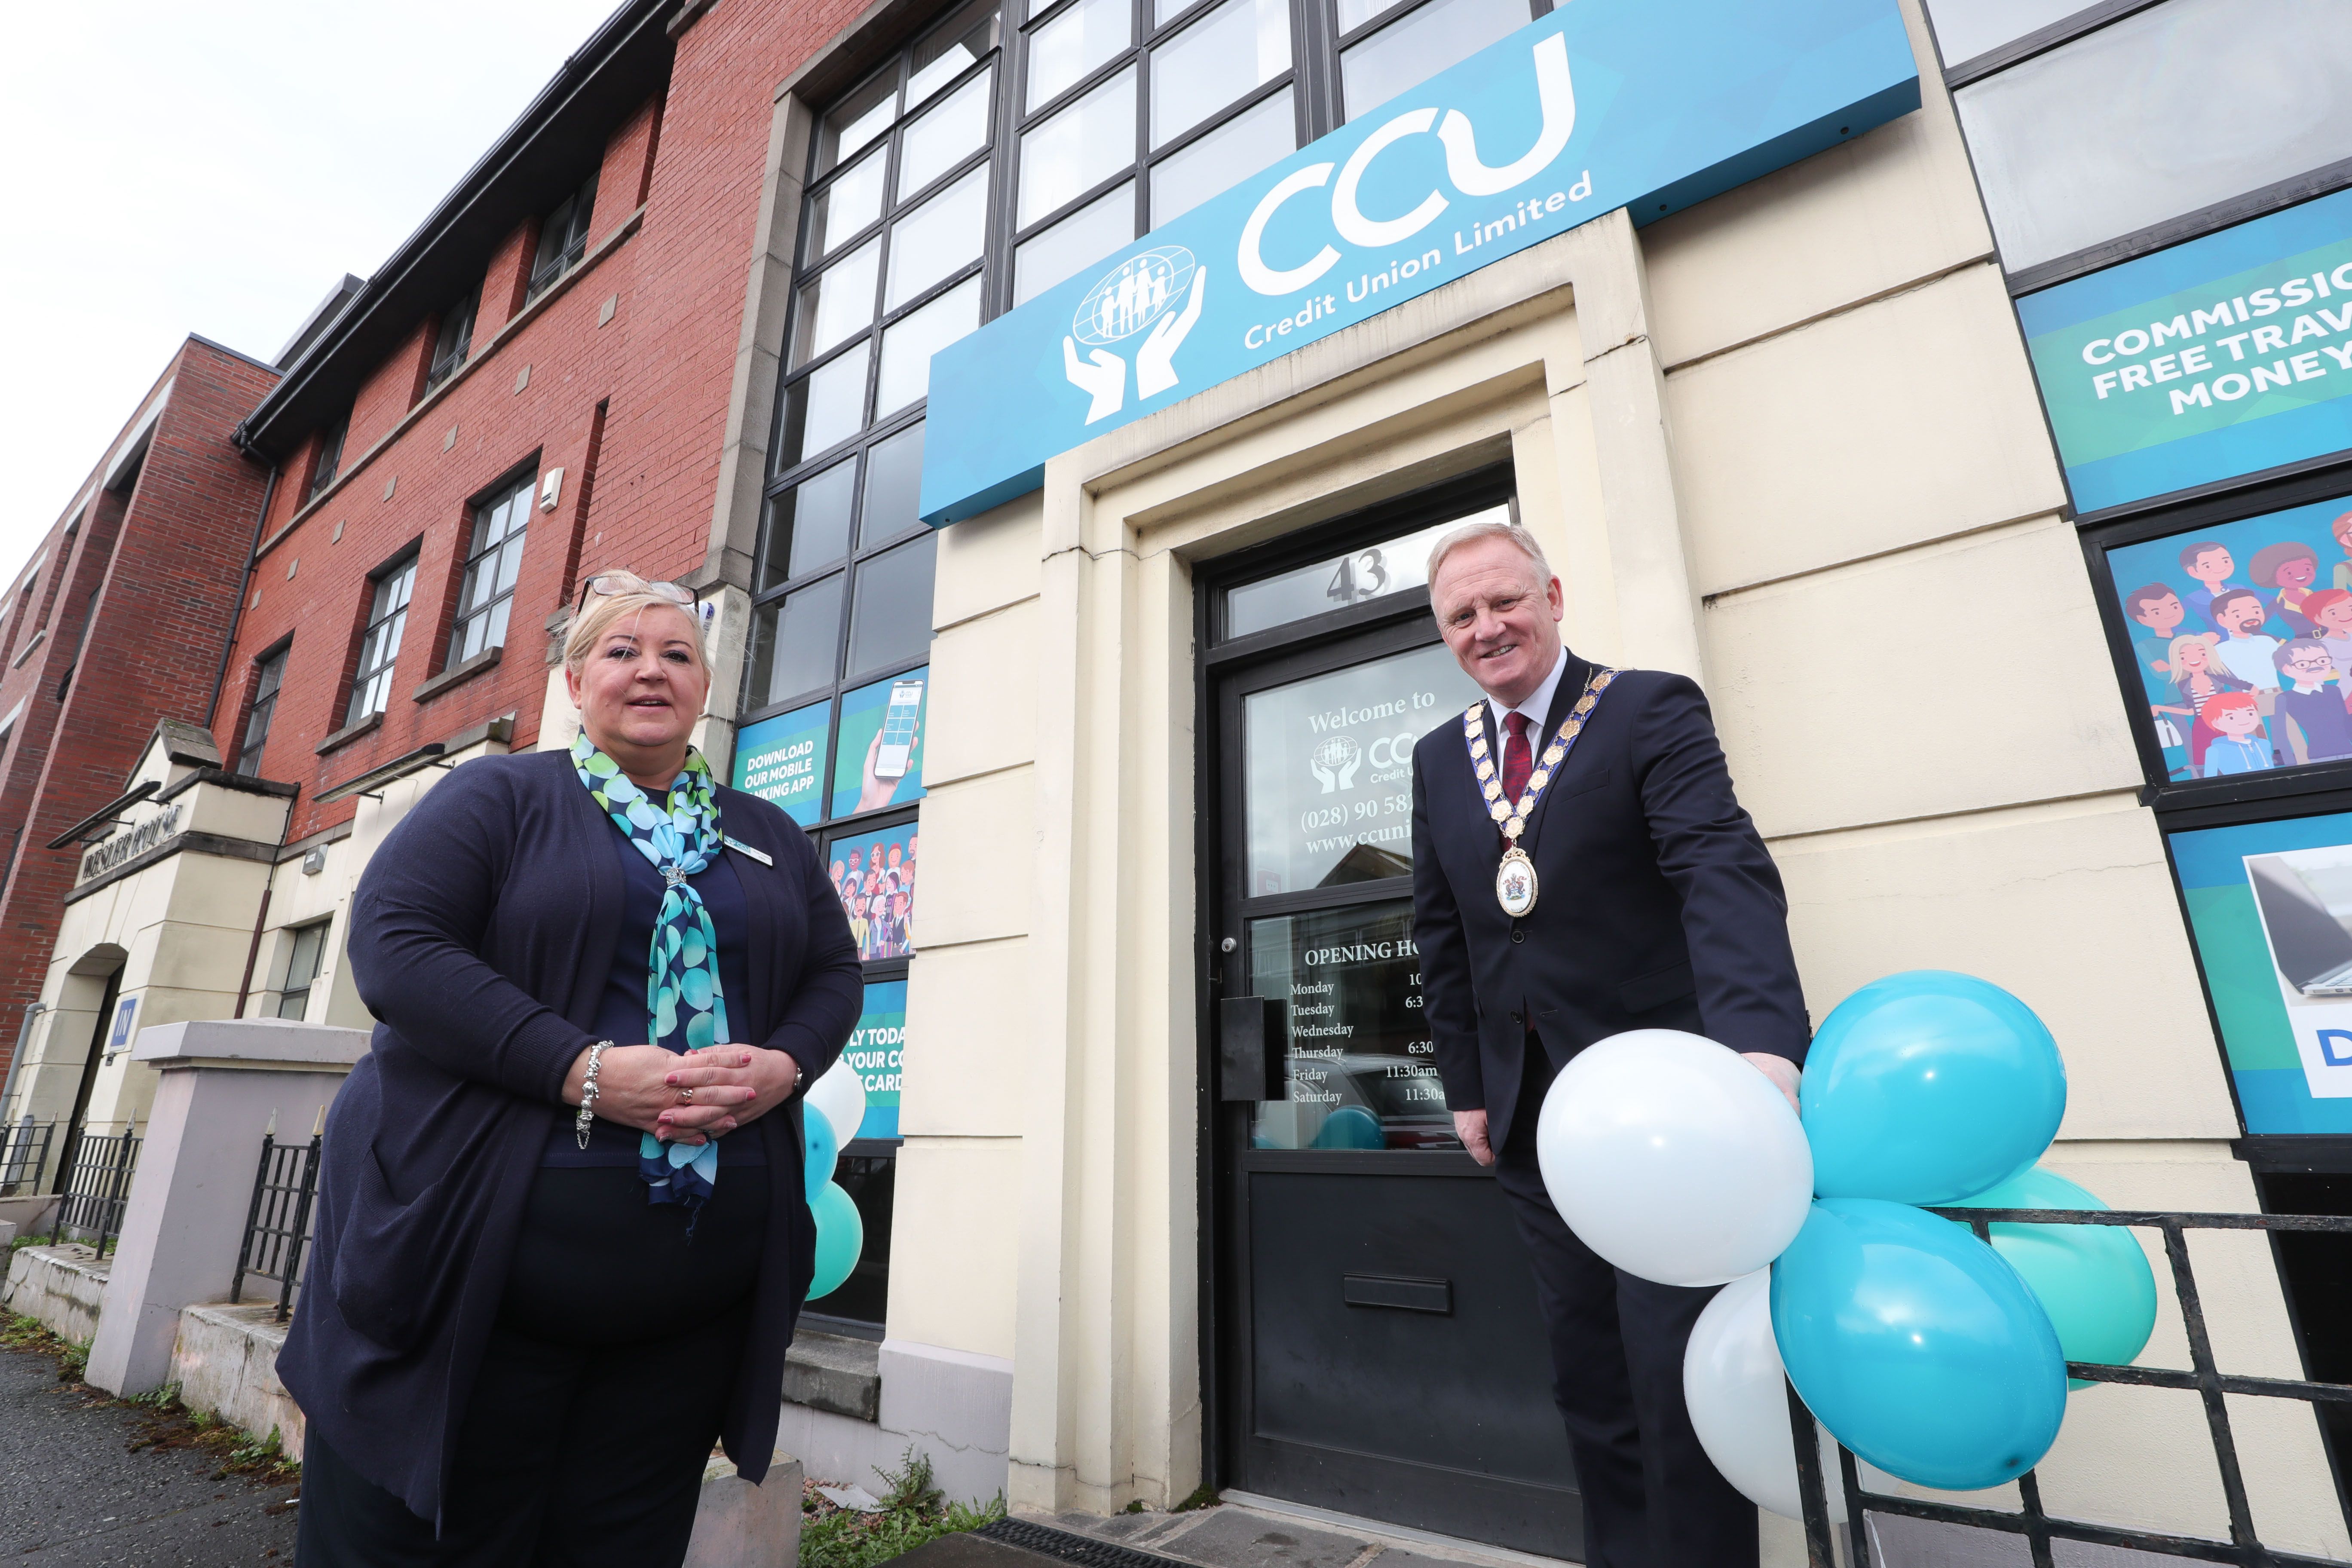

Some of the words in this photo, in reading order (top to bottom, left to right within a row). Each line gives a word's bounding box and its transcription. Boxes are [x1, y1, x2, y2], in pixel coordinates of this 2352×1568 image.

[1237, 31, 1576, 296] CCU
[1245, 293, 1335, 349] Credit
[1346, 245, 1441, 303] Union
[1455, 169, 1592, 256] Limited
[2082, 262, 2352, 365] COMMISSIO
[2092, 345, 2213, 400] FREE
[2216, 301, 2352, 361] TRAV
[2169, 340, 2352, 415] MONEY
[1327, 548, 1386, 601] 43
[1308, 699, 1406, 734] Welcome
[1411, 692, 1435, 709] to
[747, 740, 813, 772] DOWNLOAD
[1369, 732, 1419, 769] CC
[744, 771, 768, 789] OUR
[769, 757, 812, 782] MOBILE
[749, 782, 790, 801] NKING
[790, 775, 814, 794] APP
[1370, 768, 1405, 784] Credit
[1301, 803, 1348, 833] (028)
[1354, 799, 1378, 820] 90
[1305, 818, 1412, 854] www.ccuni
[1305, 942, 1392, 966] OPENING
[1290, 981, 1335, 996] Monday
[1409, 973, 1422, 985] 10
[1290, 1002, 1335, 1017] Tuesday
[1405, 995, 1423, 1008] 6:3
[115, 1009, 132, 1037] IN
[849, 1029, 866, 1047] LY
[867, 1026, 906, 1045] TODA
[1291, 1023, 1354, 1038] Wednesday
[847, 1051, 885, 1069] YOUR
[1292, 1045, 1344, 1060] Thursday
[1408, 1041, 1433, 1054] 6:30
[1292, 1068, 1328, 1084] Friday
[1386, 1065, 1438, 1078] 11:30am
[1293, 1090, 1342, 1106] Saturday
[1406, 1088, 1446, 1101] 11:30a
